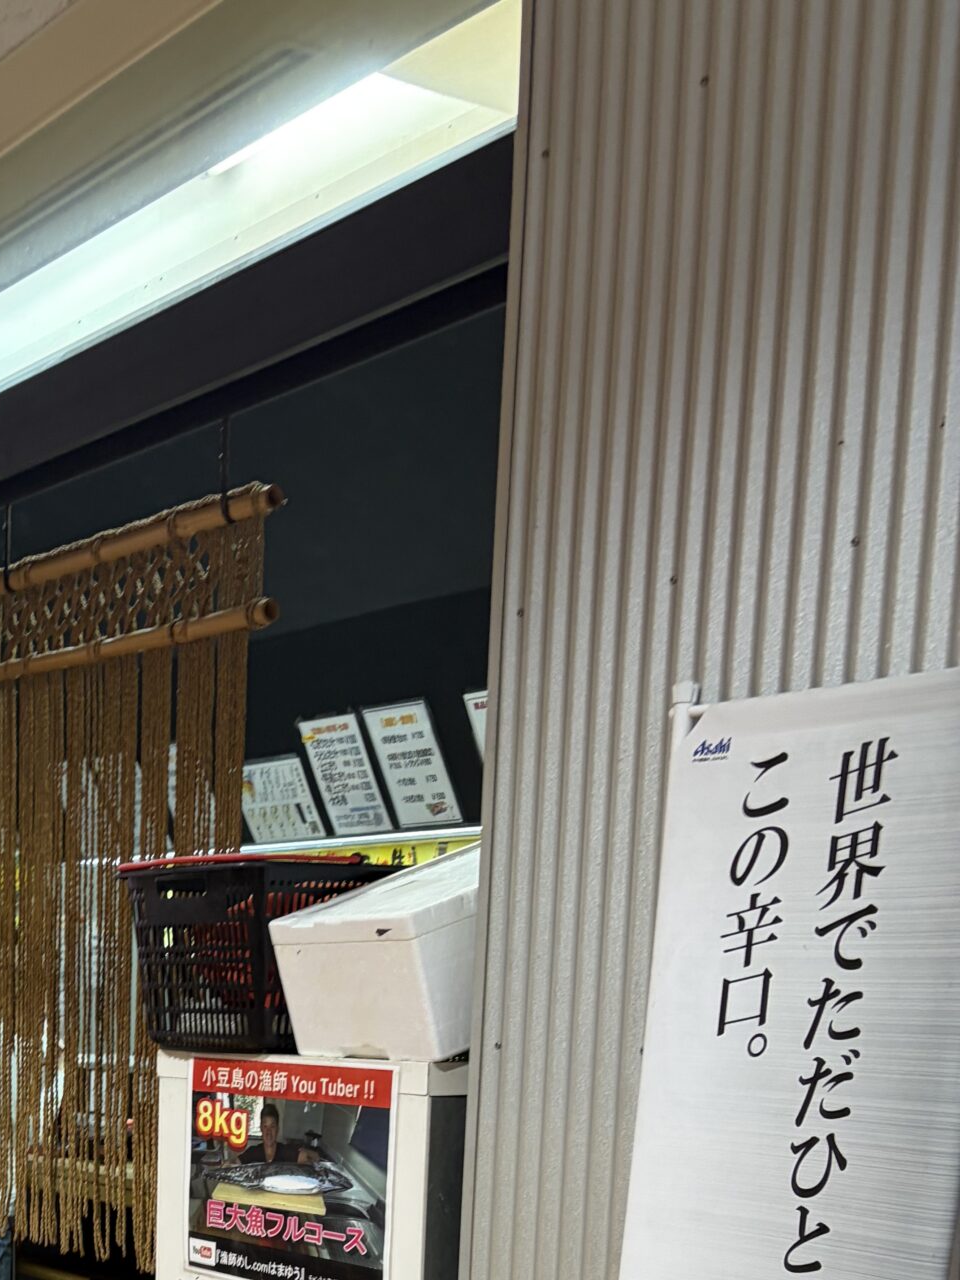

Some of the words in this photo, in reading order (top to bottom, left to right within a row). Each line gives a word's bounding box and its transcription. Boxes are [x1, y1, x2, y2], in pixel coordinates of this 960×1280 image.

[717, 752, 789, 1057] この辛口。
[202, 1066, 288, 1094] 小豆島の漁師
[291, 1077, 316, 1095] You
[320, 1078, 360, 1098] Tuber
[197, 1100, 248, 1146] 8kg
[207, 1199, 368, 1256] 巨大魚フルコース
